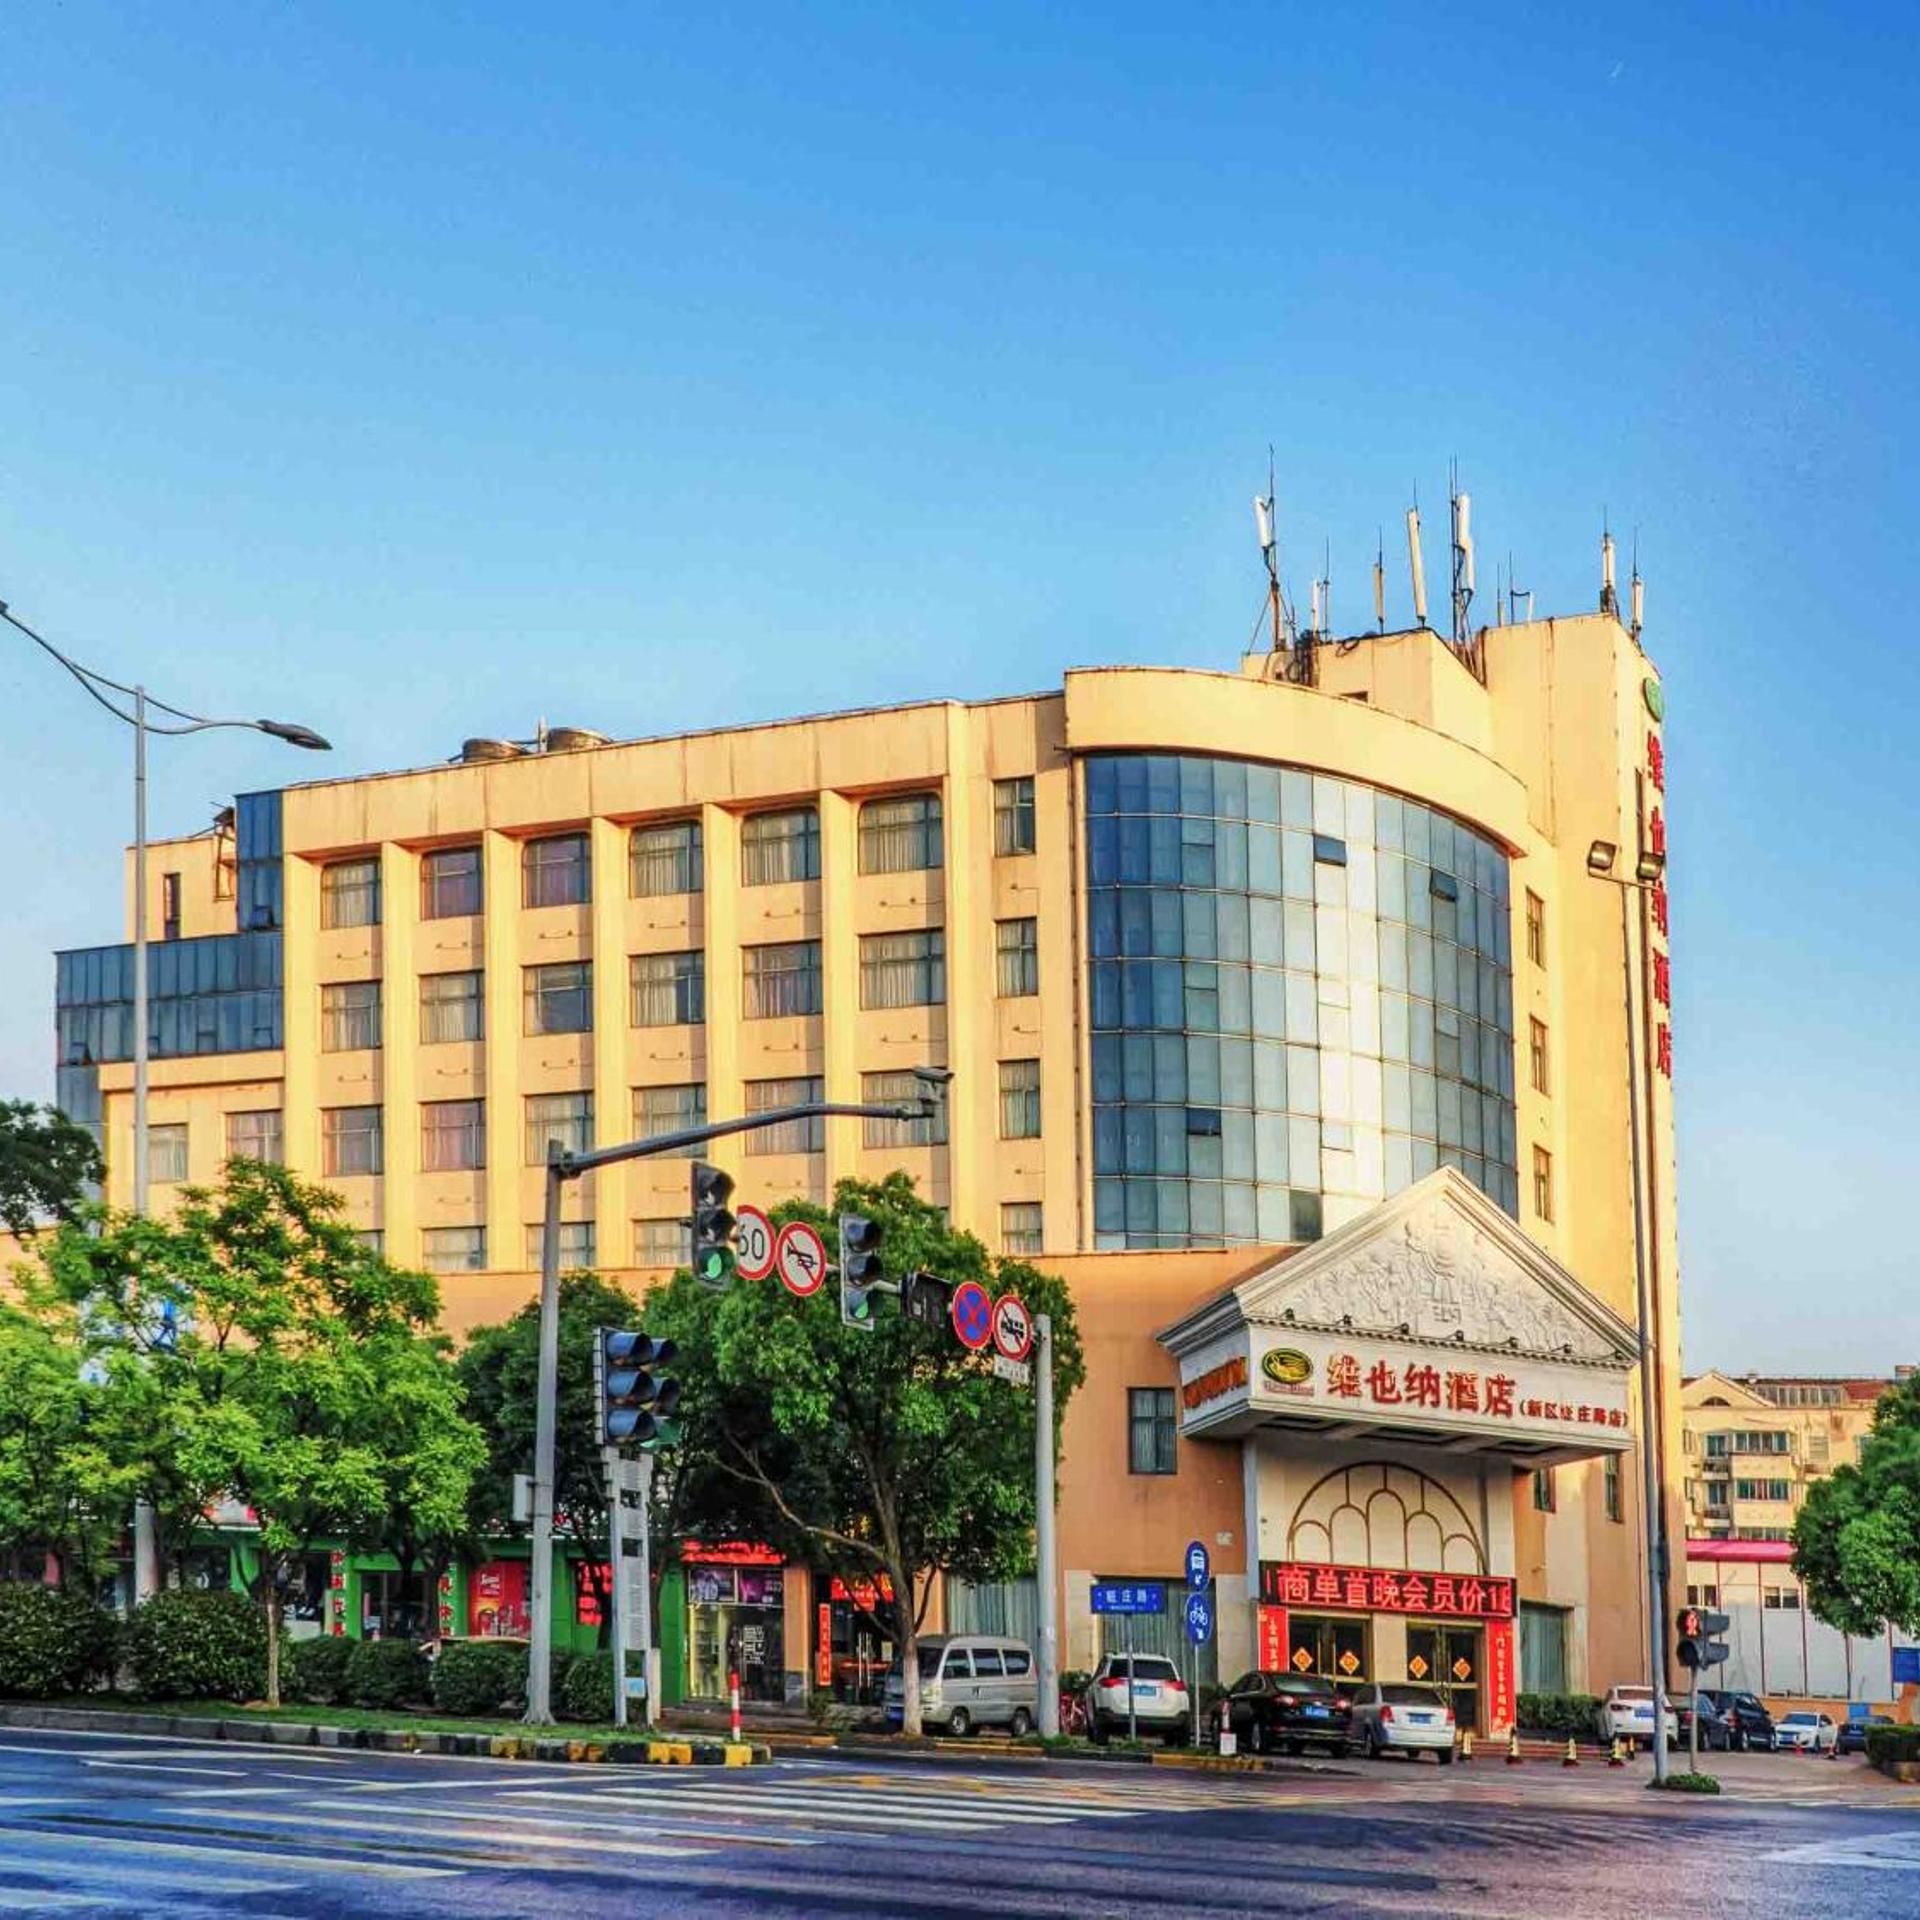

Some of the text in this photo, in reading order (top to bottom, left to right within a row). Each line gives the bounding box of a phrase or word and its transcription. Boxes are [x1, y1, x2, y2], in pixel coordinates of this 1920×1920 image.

[1326, 1353, 1516, 1419] 维也纳酒店
